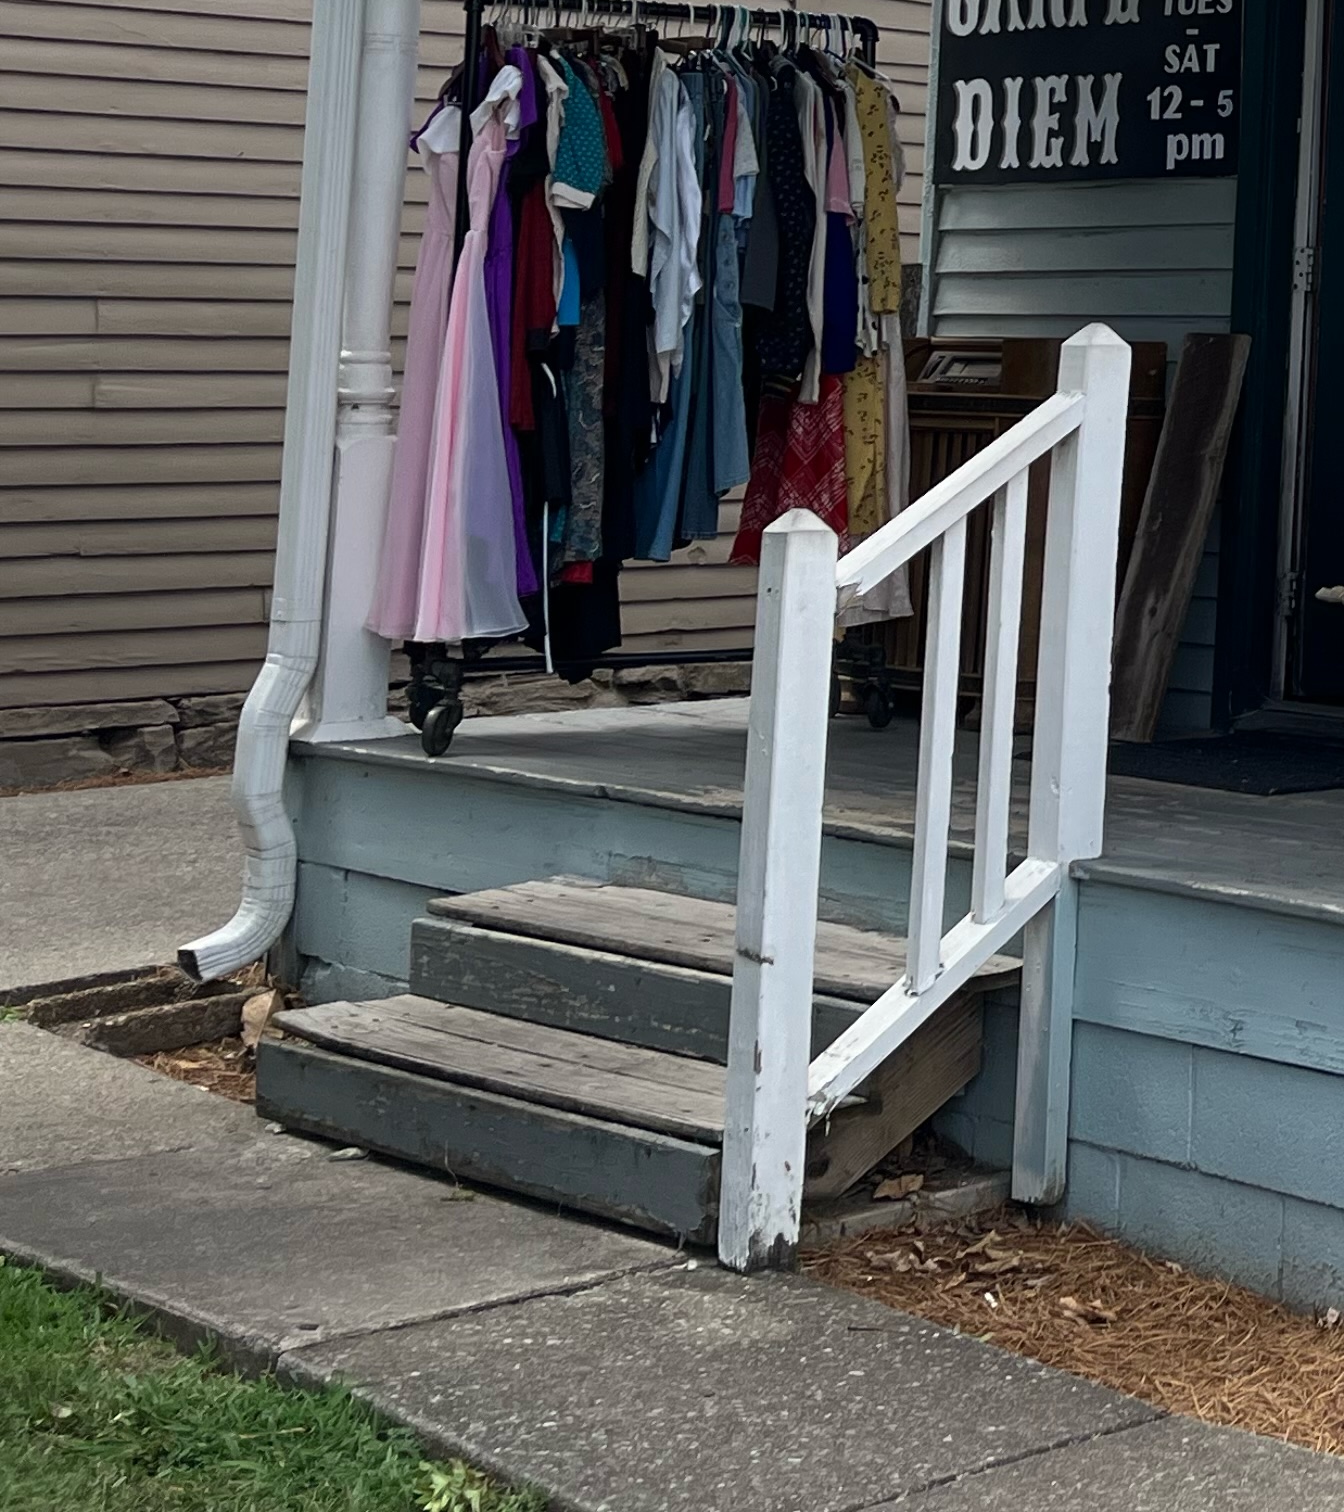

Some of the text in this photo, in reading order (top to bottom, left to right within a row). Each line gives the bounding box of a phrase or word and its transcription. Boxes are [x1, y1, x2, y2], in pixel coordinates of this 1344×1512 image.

[1163, 43, 1220, 74] SAT
[952, 72, 1123, 171] DIEM
[1166, 132, 1225, 170] pm
